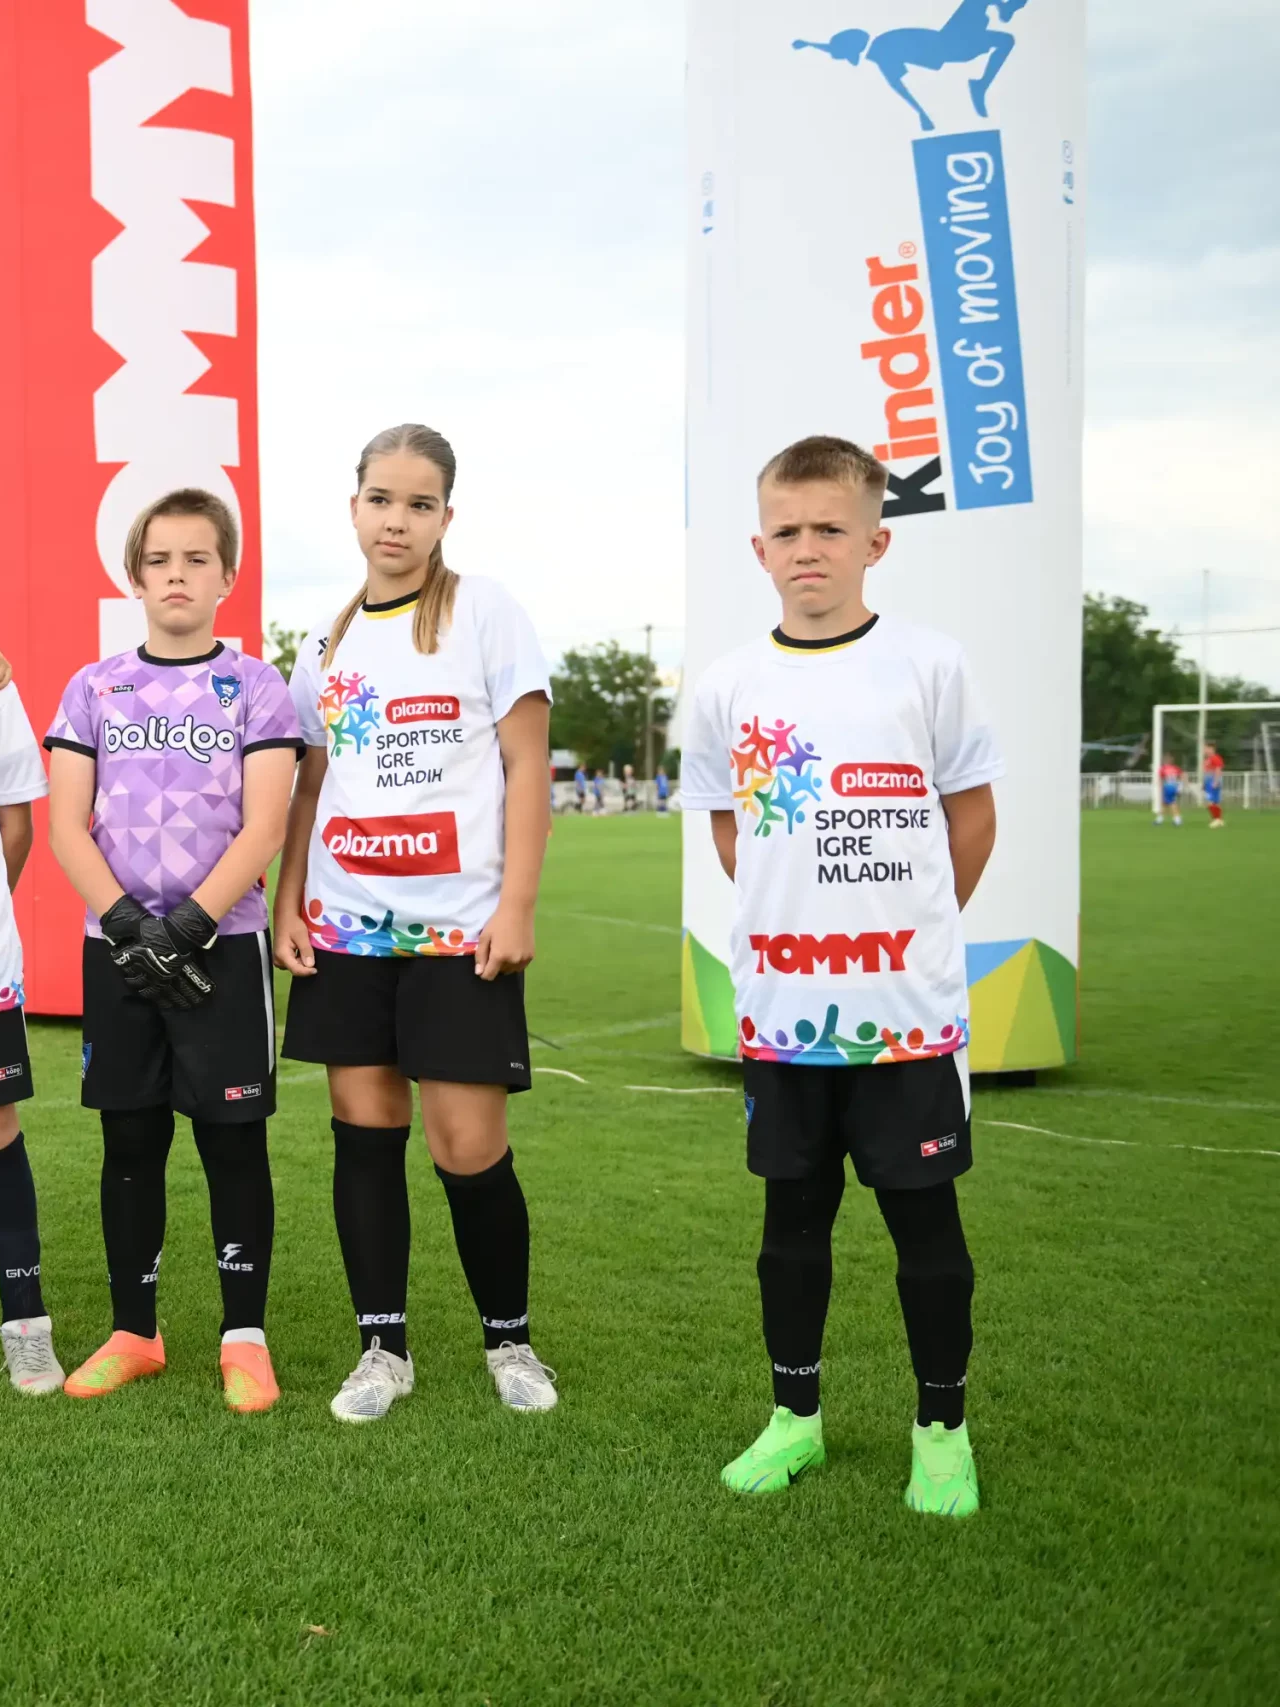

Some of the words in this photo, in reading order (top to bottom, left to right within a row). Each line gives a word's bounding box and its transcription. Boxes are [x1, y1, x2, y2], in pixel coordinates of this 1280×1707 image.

[939, 150, 1001, 325] moving
[86, 0, 244, 660] OMMY
[953, 338, 1005, 387] of
[969, 400, 1019, 490] Joy
[391, 701, 453, 723] plazma
[103, 714, 236, 764] balidoo
[376, 728, 464, 751] SPORTSKE
[376, 750, 415, 770] IGRE
[376, 768, 443, 788] MLADIH
[840, 769, 921, 793] plazma
[814, 808, 930, 831] SPORTSKE
[816, 835, 873, 858] IGRE
[818, 861, 913, 885] MLADIH
[748, 929, 917, 975] TOMMY
[6, 1264, 40, 1278] GIVO
[482, 1312, 528, 1330] LEGE
